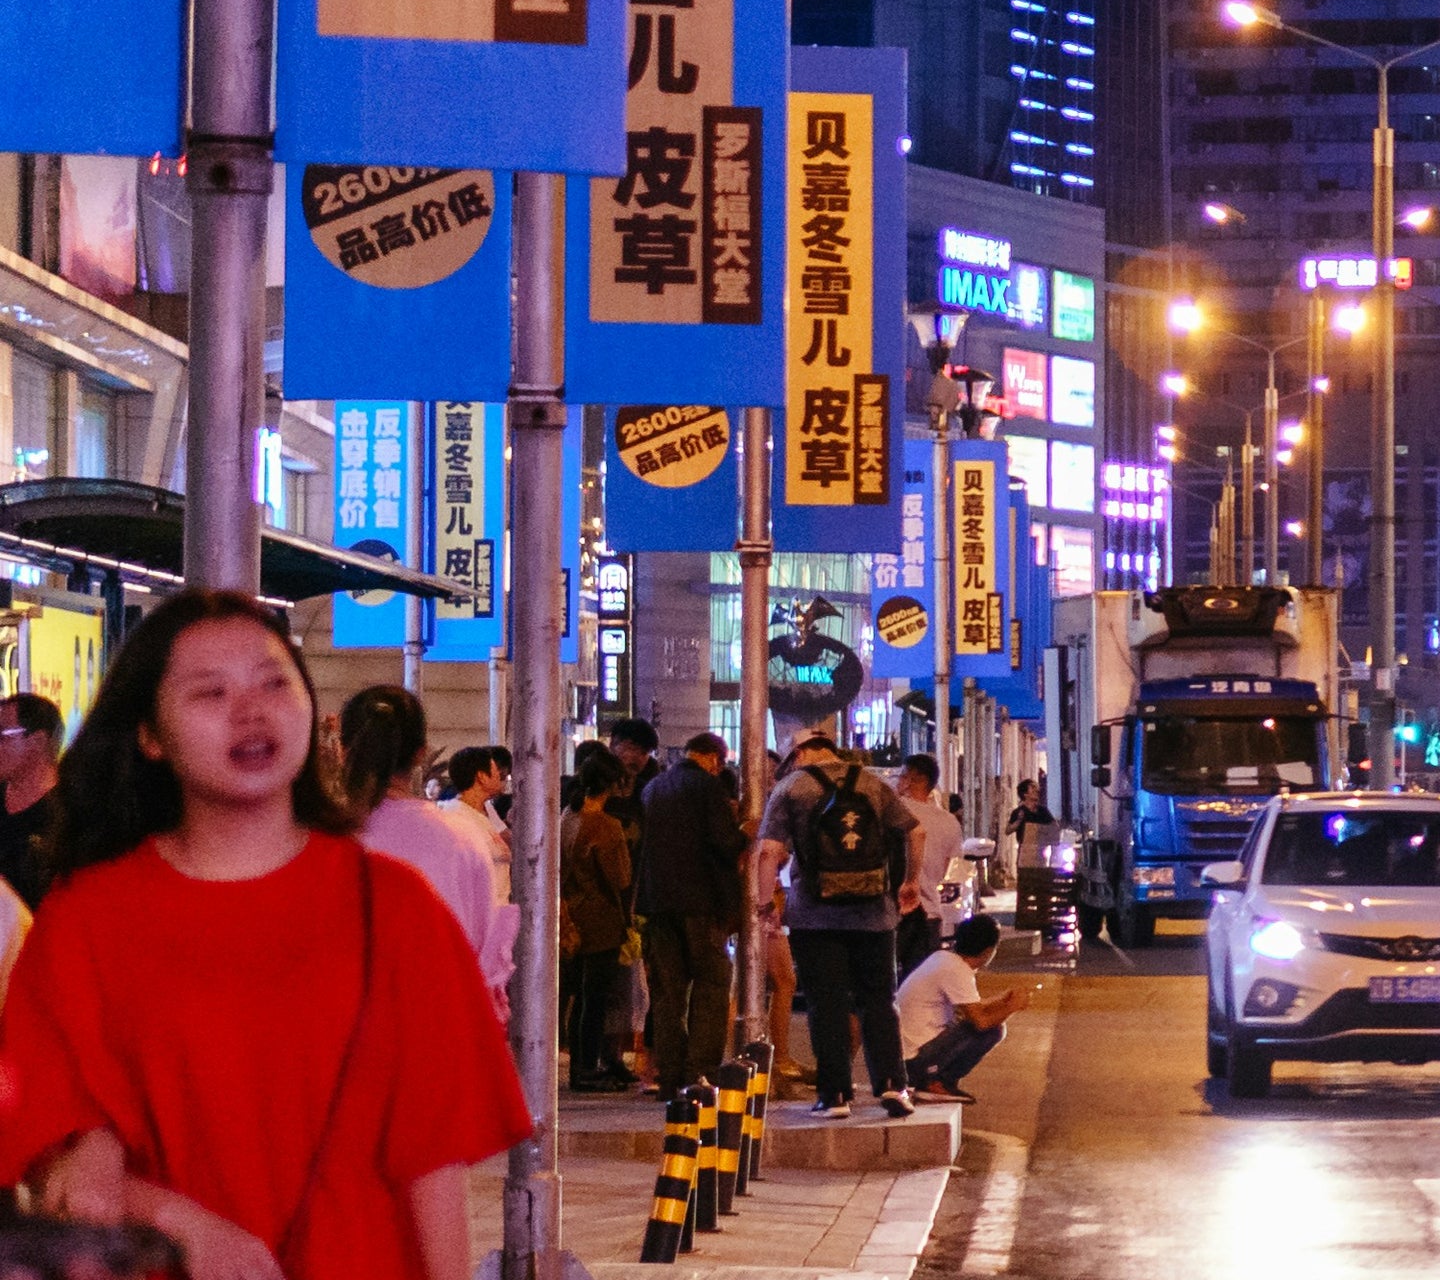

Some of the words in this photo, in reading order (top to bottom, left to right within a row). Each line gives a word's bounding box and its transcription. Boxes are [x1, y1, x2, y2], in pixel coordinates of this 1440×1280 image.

[335, 181, 492, 272] 品高价低
[712, 122, 752, 307] 罗斯福大堂
[799, 111, 852, 489] 贝嘉冬雪儿皮草
[945, 268, 1009, 313] IMAX
[442, 402, 473, 609] 嘉冬雪儿皮
[635, 424, 728, 477] 品高价低
[962, 469, 986, 646] 贝嘉冬雪儿皮草
